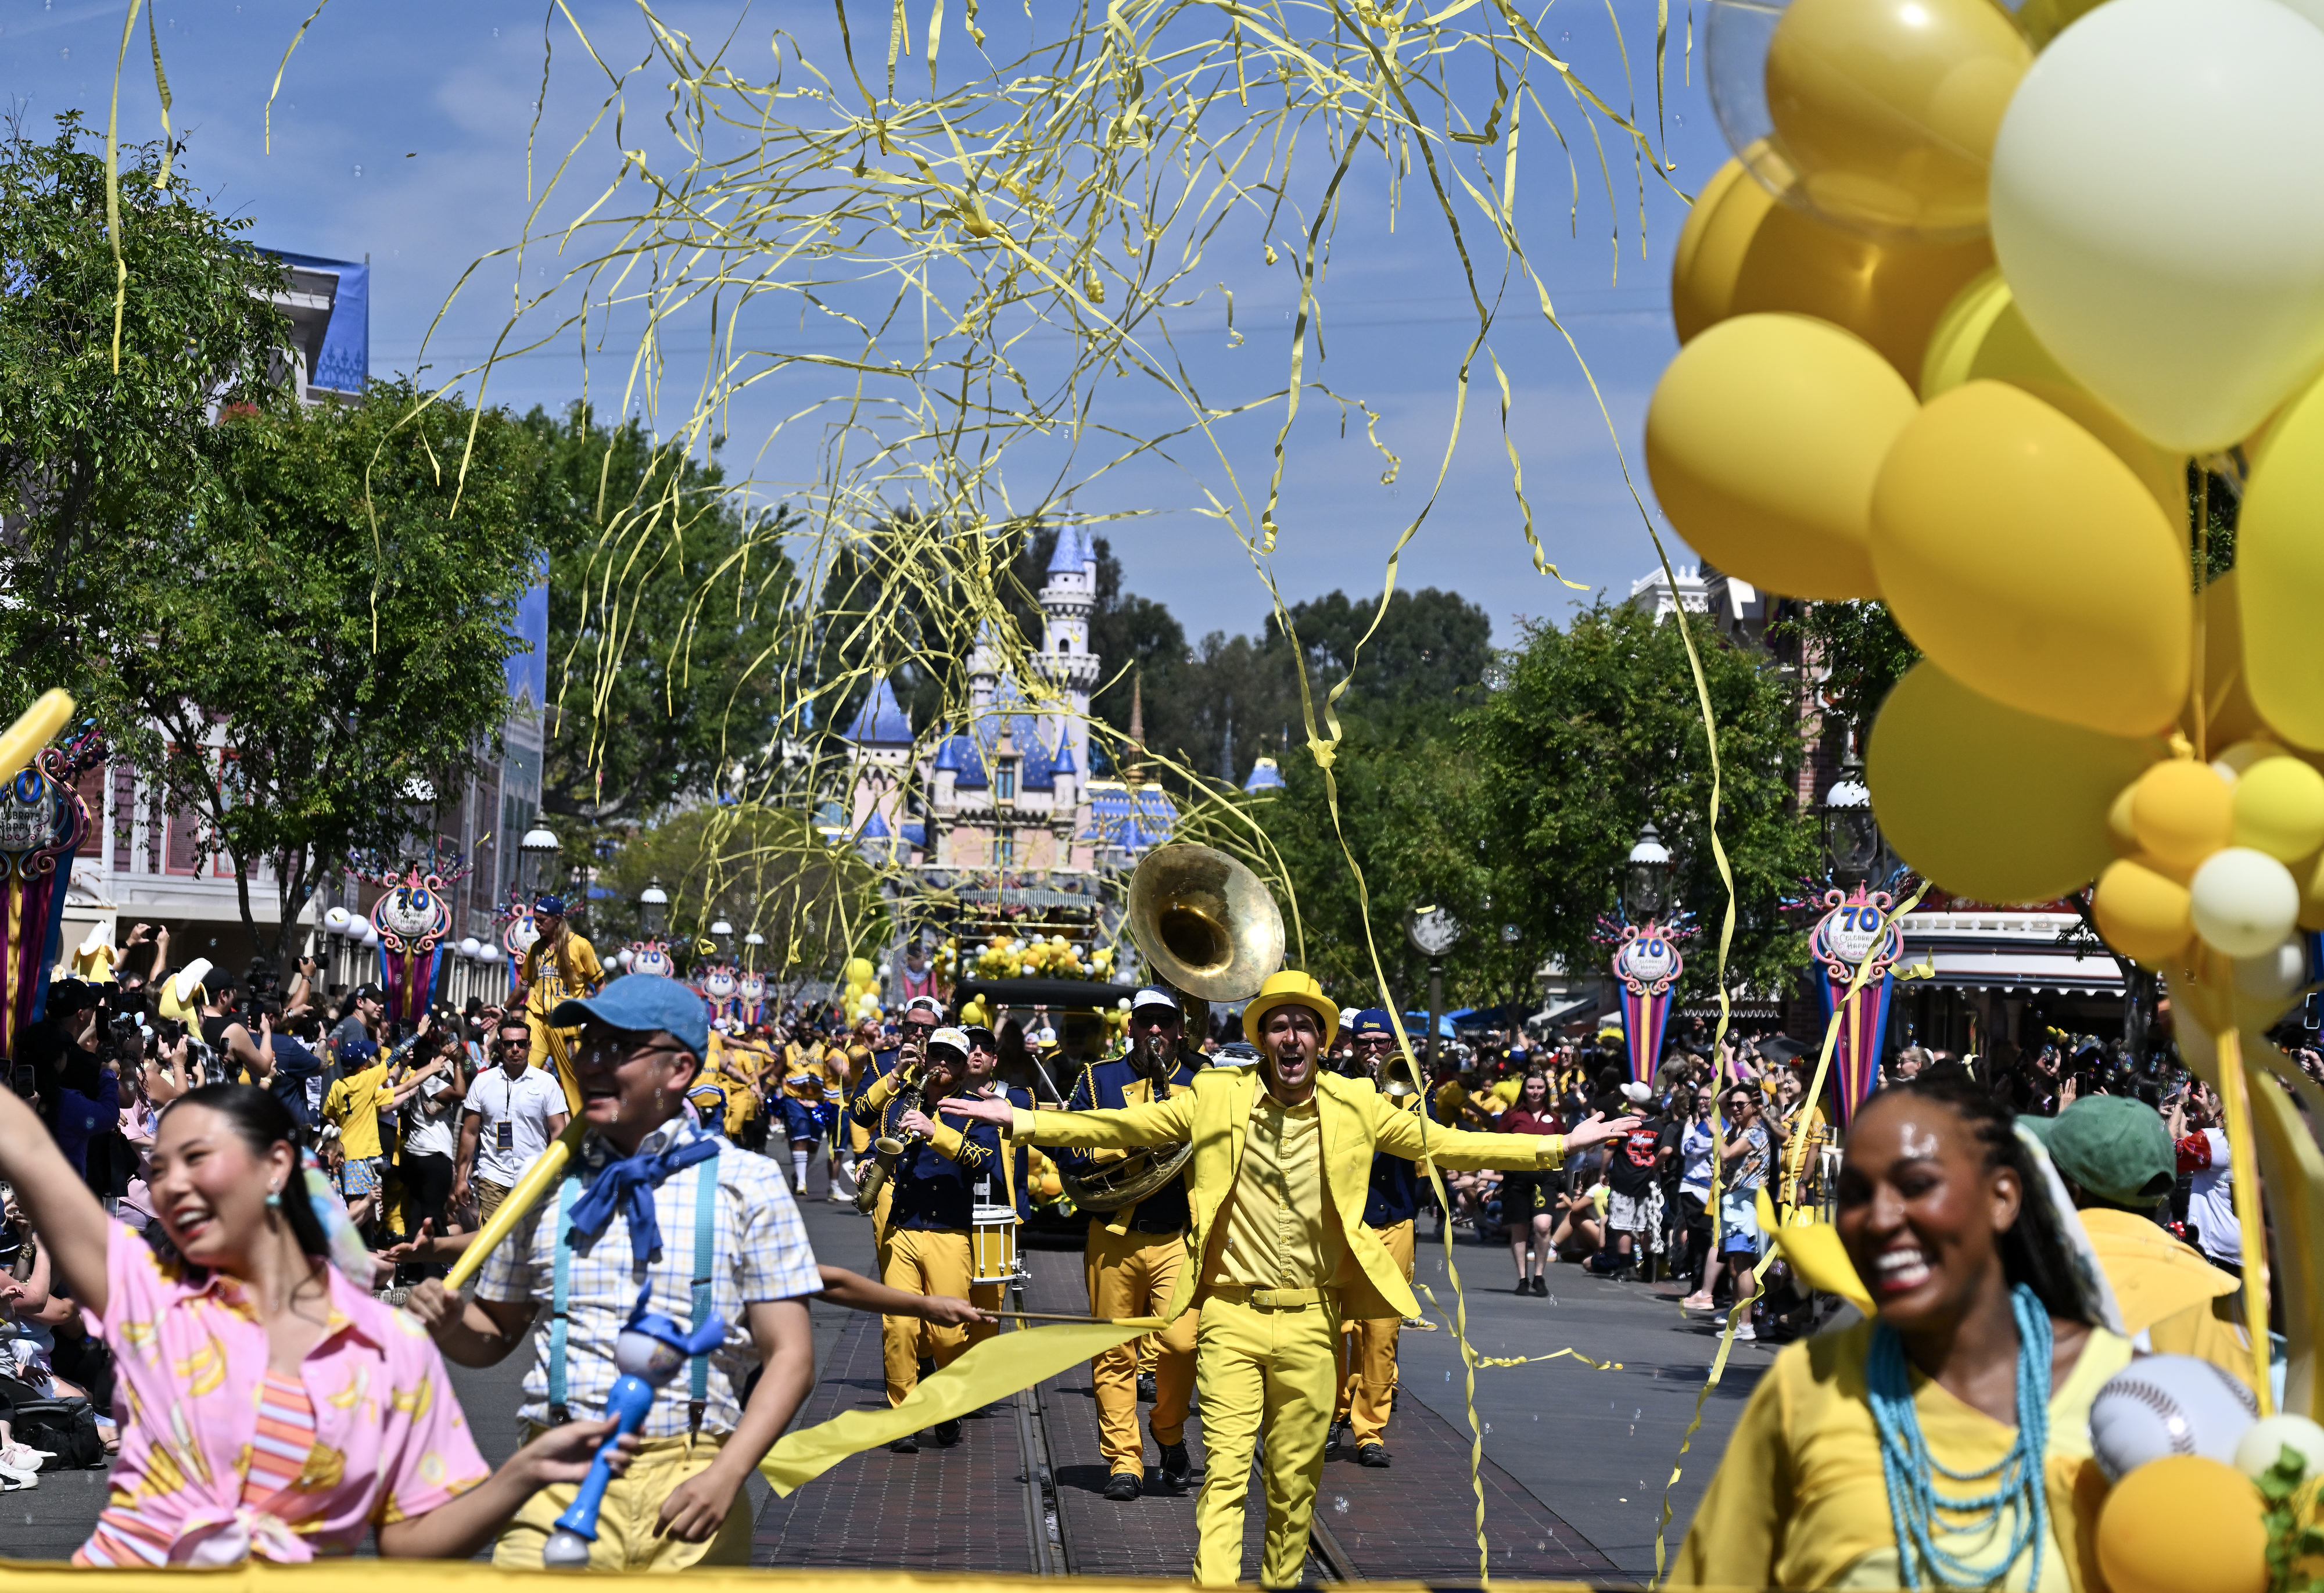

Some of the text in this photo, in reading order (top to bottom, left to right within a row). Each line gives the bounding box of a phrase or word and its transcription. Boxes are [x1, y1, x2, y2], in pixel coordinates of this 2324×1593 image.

[1841, 905, 1880, 932] 70
[1635, 938, 1665, 957] 70
[641, 950, 661, 963] 70
[715, 973, 730, 984] 70
[555, 982, 569, 997] 14
[1631, 1133, 1655, 1144] Mouse
[1627, 1141, 1656, 1167] 55
